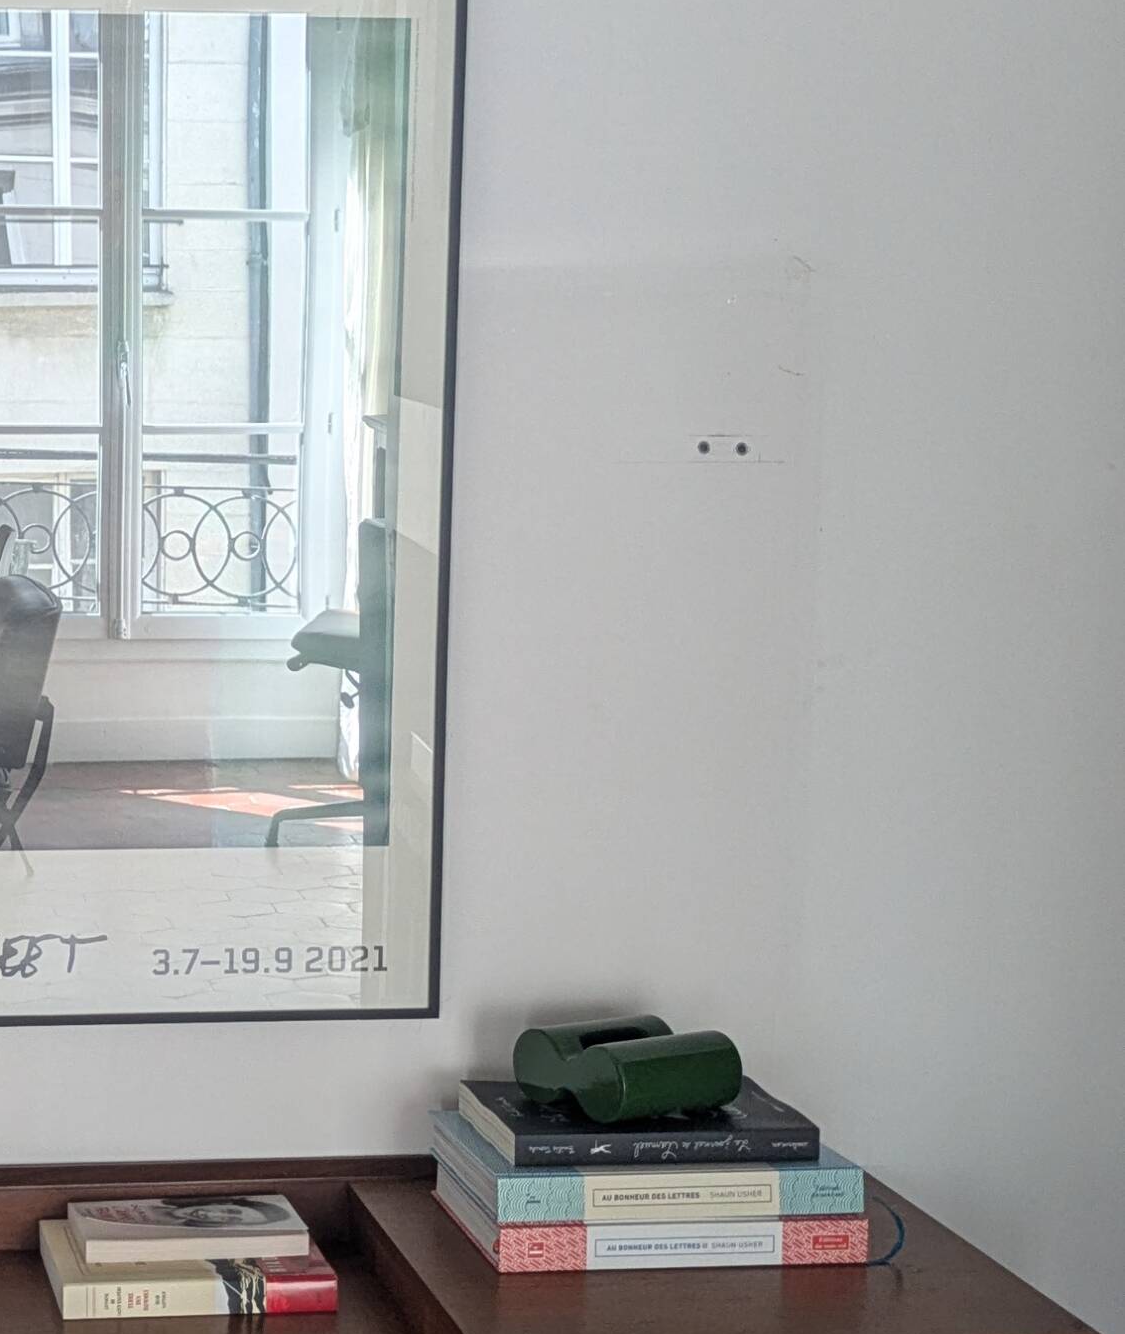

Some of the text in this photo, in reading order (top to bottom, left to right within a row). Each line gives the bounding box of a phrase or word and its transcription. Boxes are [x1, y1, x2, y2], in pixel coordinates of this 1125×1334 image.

[304, 946, 390, 974] 2021
[601, 1191, 701, 1202] AU BONHEUR DES LETTRES
[737, 1189, 763, 1198] USHER
[606, 1244, 617, 1252] AU
[618, 1243, 653, 1252] BONHEUR
[654, 1242, 668, 1251] DES
[669, 1242, 701, 1250] LETTRES
